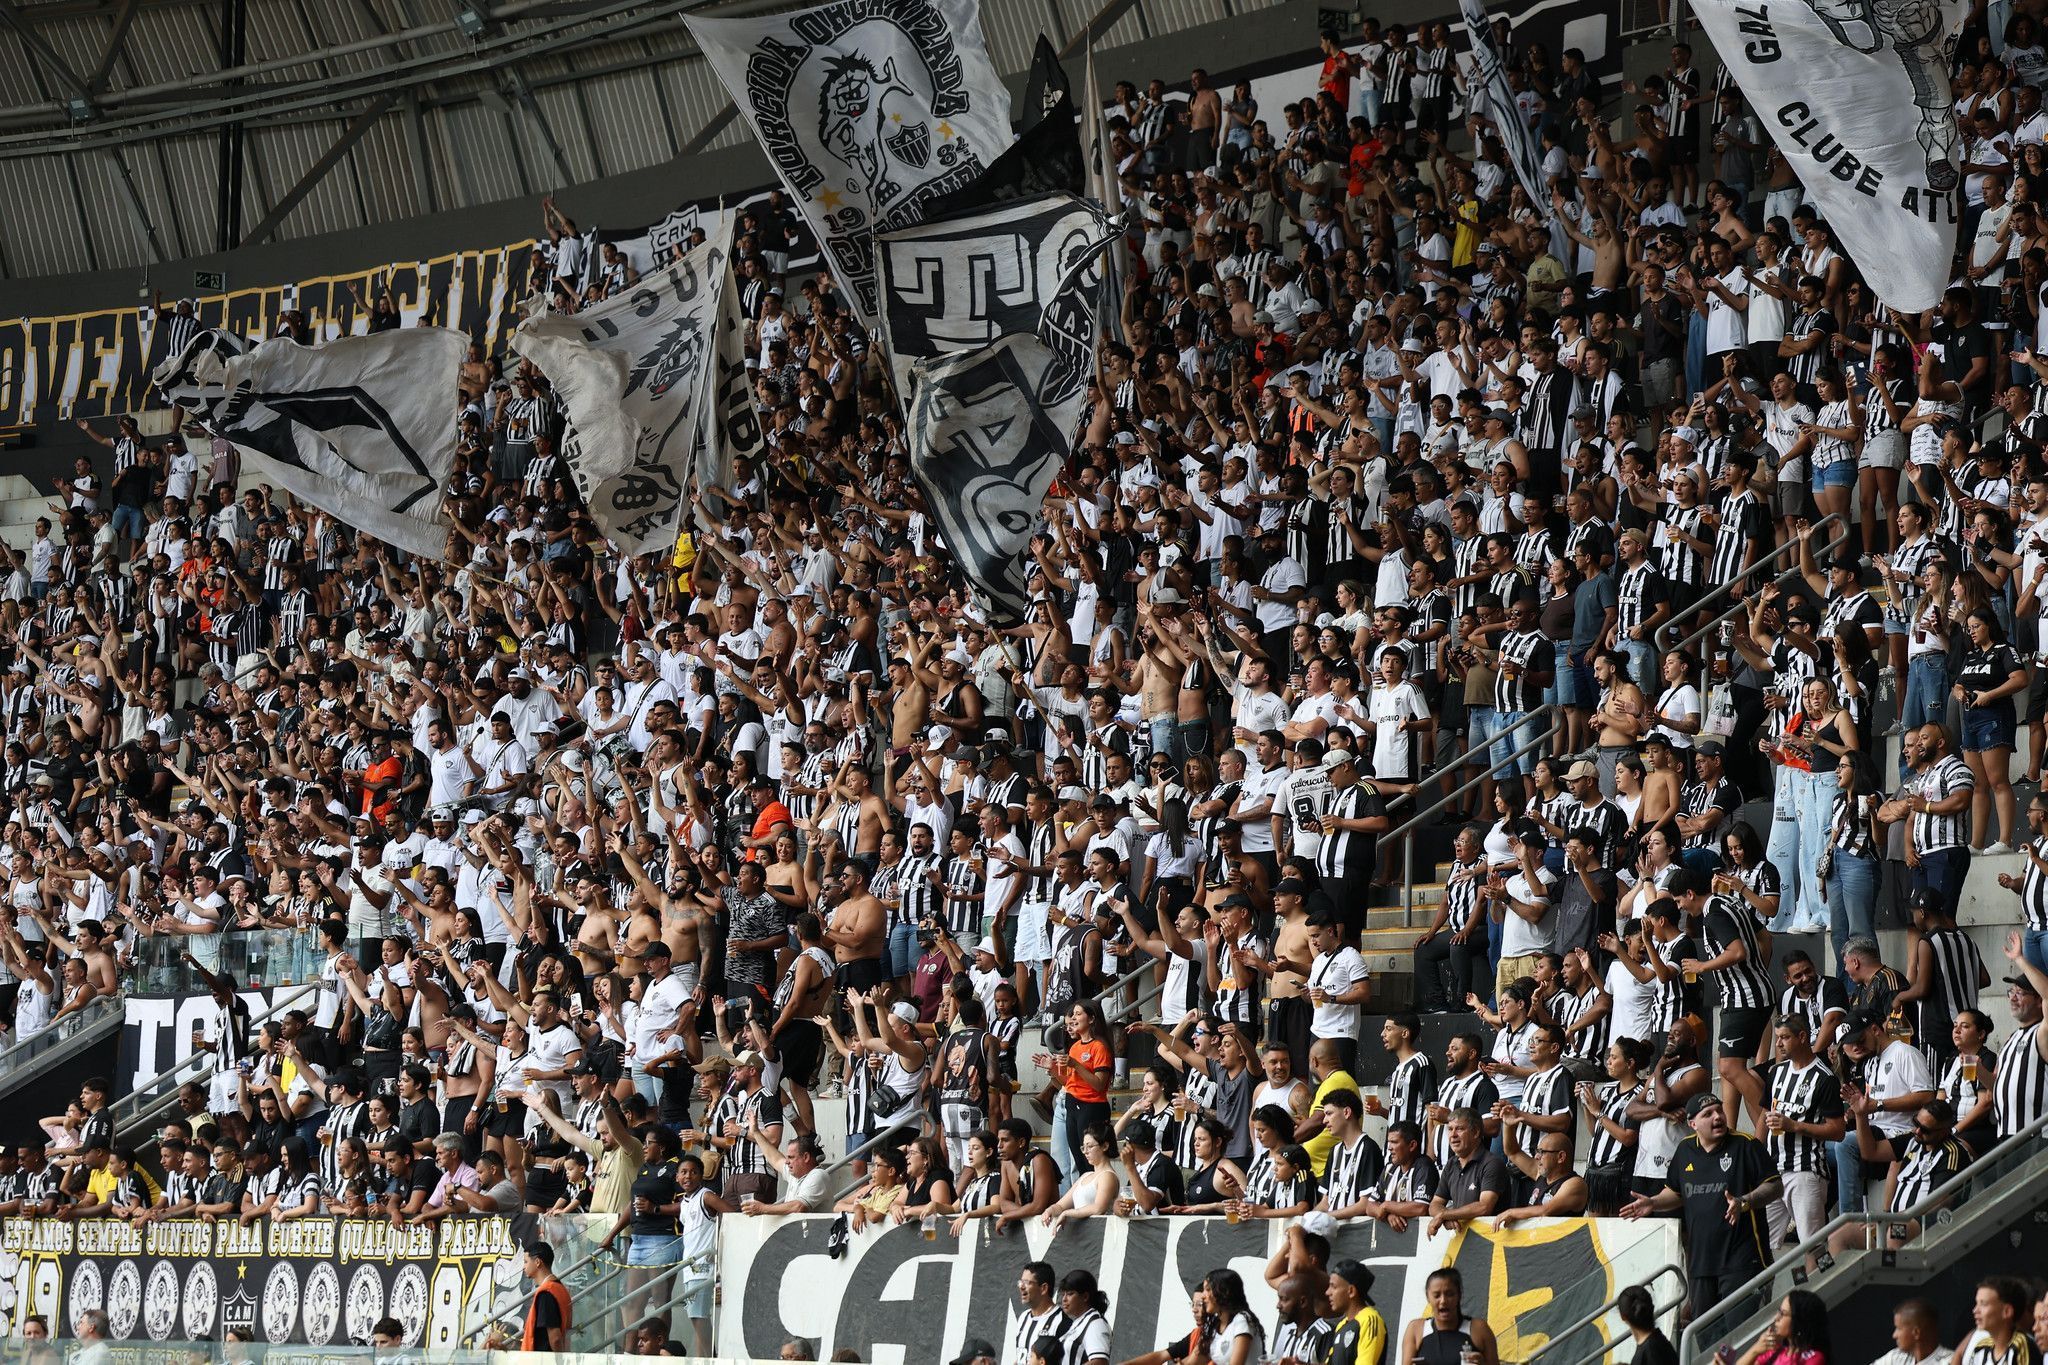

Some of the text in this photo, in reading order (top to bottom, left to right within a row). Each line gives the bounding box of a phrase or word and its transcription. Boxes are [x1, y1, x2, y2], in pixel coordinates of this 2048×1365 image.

[747, 37, 825, 202] TORCIDA
[893, 128, 923, 147] CAM
[936, 135, 971, 166] 84
[1777, 101, 1884, 197] CLUBE
[823, 206, 866, 235] 19
[657, 221, 692, 247] CAM
[1290, 775, 1330, 791] galoucur
[1418, 892, 1426, 905] H
[1388, 957, 1396, 970] G
[3, 1217, 516, 1265] ESTAMOS SEMPRE JUNTOS PARA CURTIR QUALQUER PARADA
[226, 1305, 251, 1321] CAM
